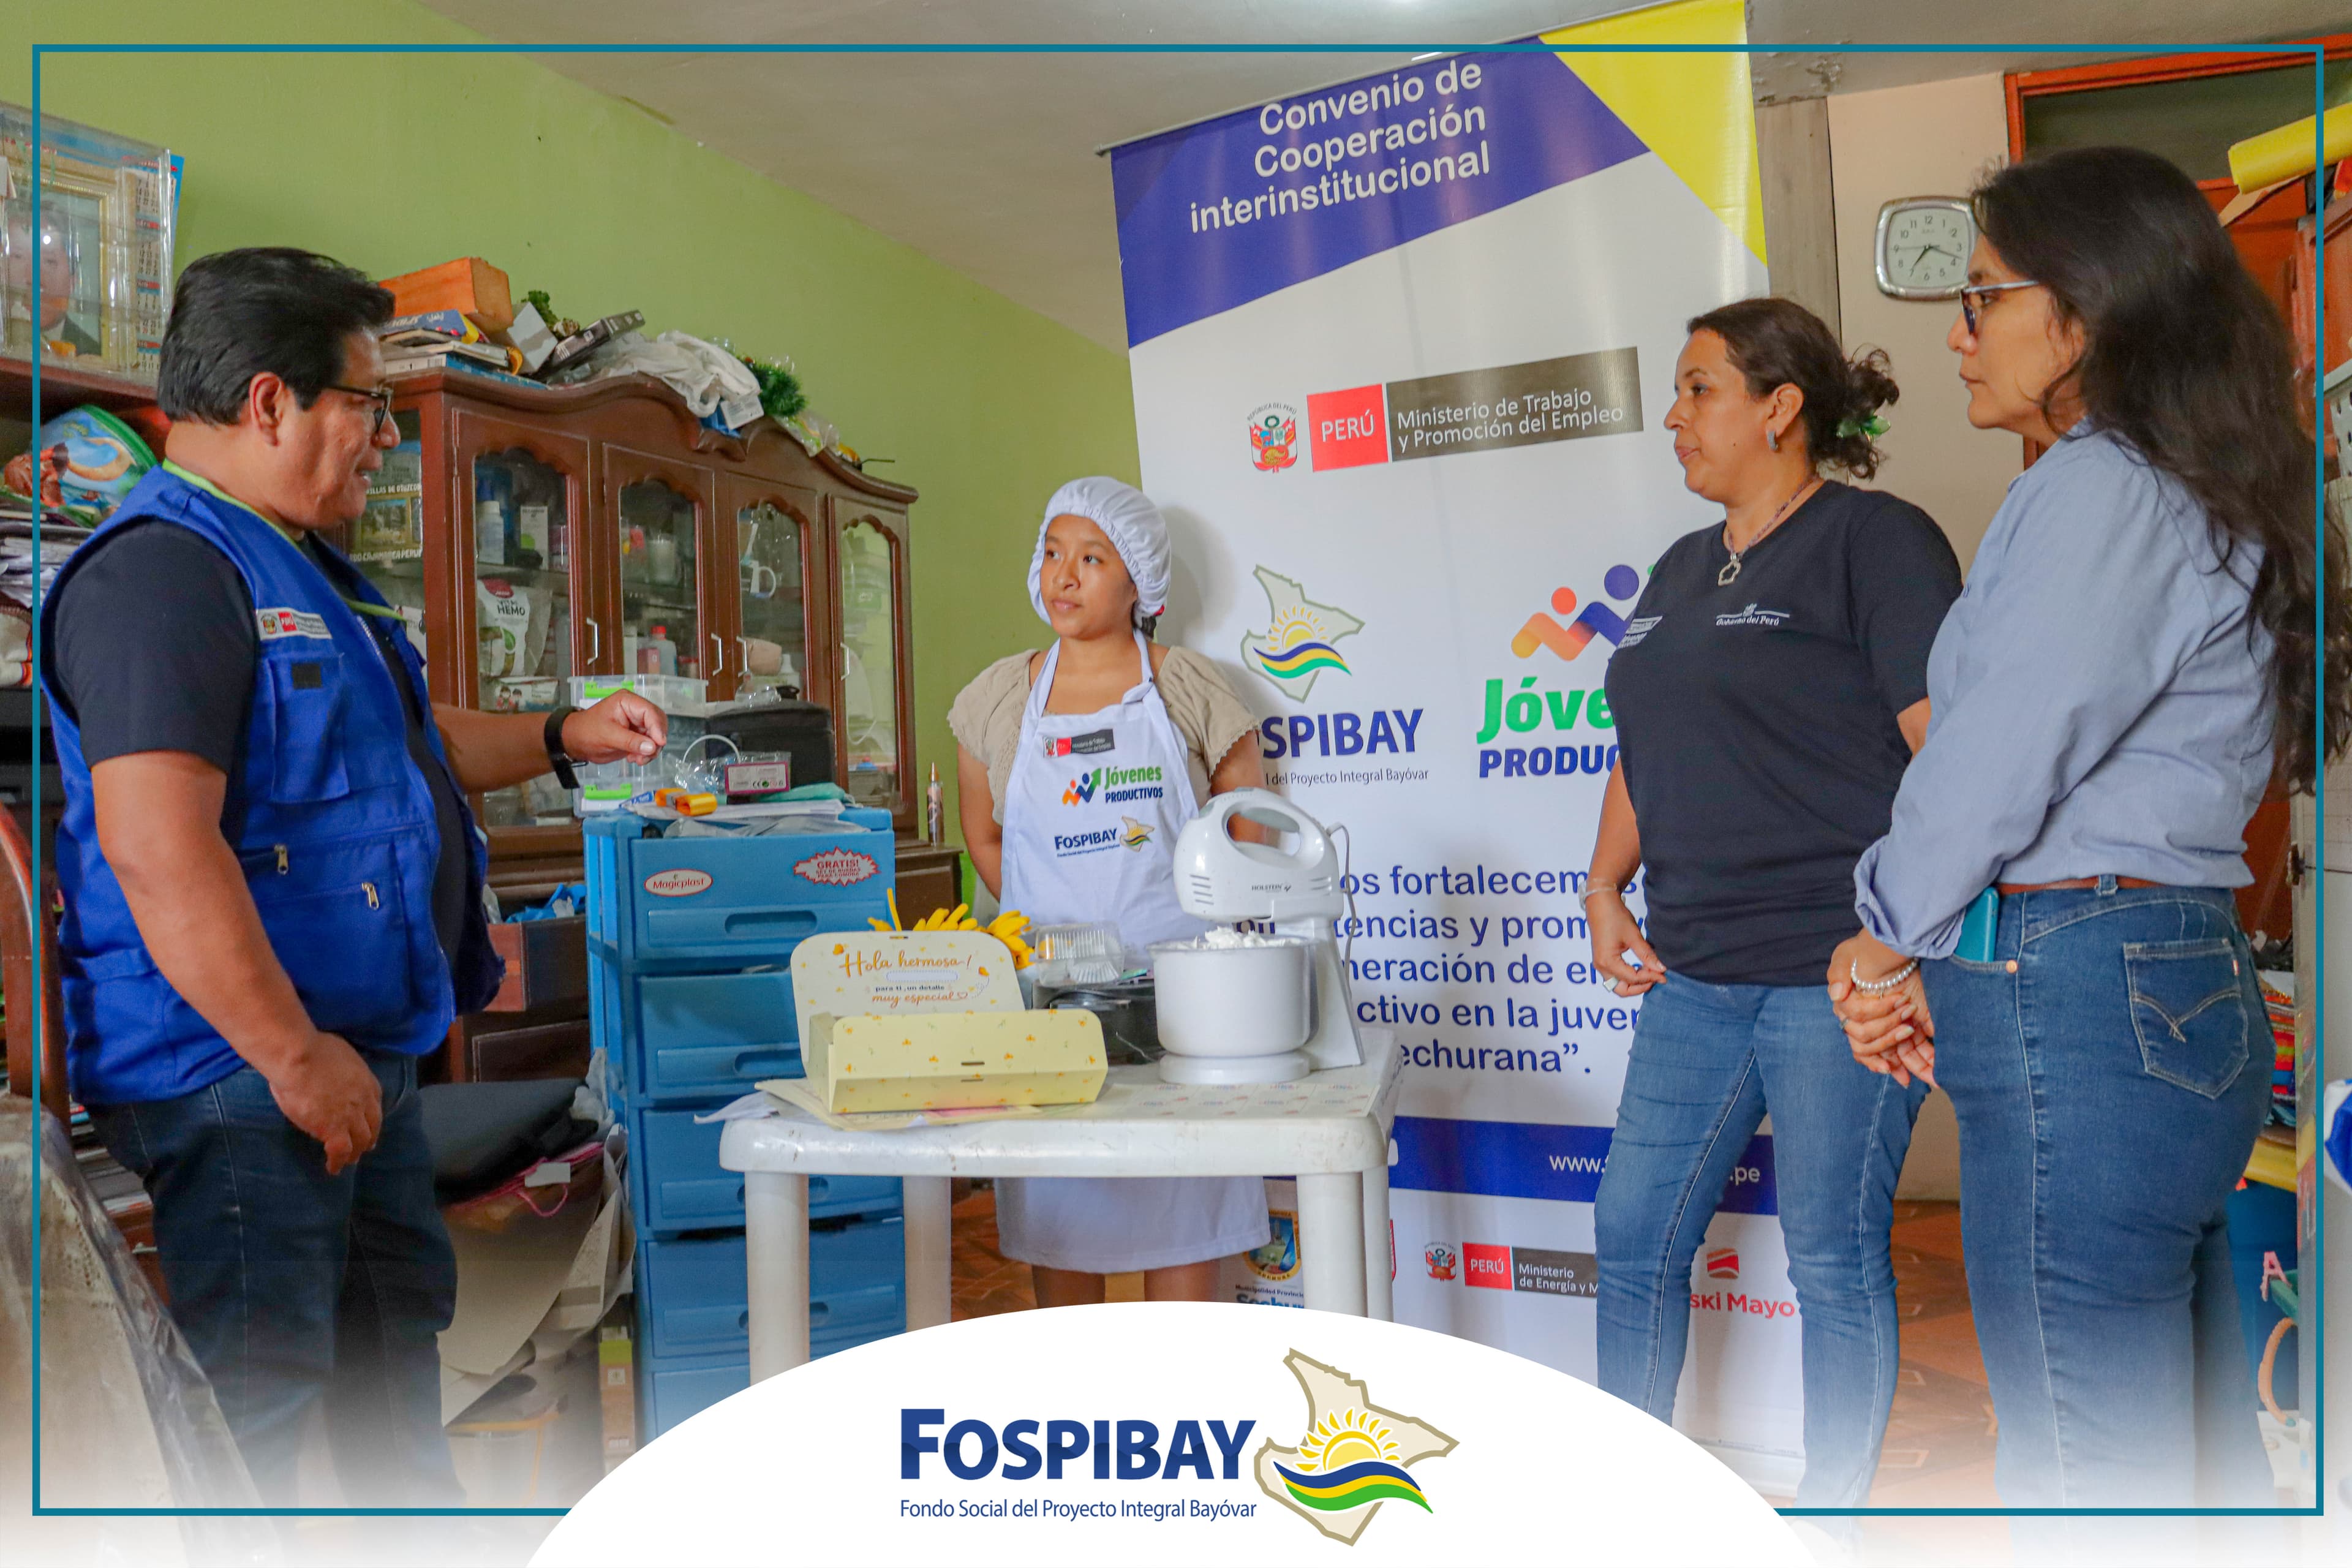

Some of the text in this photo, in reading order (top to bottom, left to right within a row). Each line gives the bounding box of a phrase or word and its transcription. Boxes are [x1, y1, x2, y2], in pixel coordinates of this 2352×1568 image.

[1260, 59, 1482, 135] Convenio de
[1254, 104, 1486, 178] Cooperación
[1190, 140, 1491, 233] interinstitucional
[1398, 388, 1592, 429] Ministerio de Trabajo
[1321, 409, 1374, 442] PERÚ
[1398, 405, 1624, 453] y Promoción del Empleo
[1476, 676, 1615, 744] Jóve
[1257, 708, 1424, 759] SPIBAY
[1104, 766, 1163, 790] Jóvenes
[1272, 772, 1288, 785] del
[1291, 772, 1337, 787] Proyecto
[1340, 768, 1383, 785] Integral
[1386, 766, 1429, 784] Bayóvar
[1105, 787, 1163, 804] PRODUCTIVOS
[1054, 827, 1117, 850] FOSPIBAY
[653, 877, 705, 891] Magicplast
[1339, 873, 1381, 895] os
[1470, 916, 1489, 947] y
[839, 950, 892, 978] Hola
[1507, 954, 1553, 984] de
[872, 992, 954, 1009] muy especial
[1357, 995, 1640, 1036] ctivo en la juve
[1549, 1155, 1607, 1174] www.
[1470, 1257, 1505, 1275] PERÚ
[1519, 1263, 1574, 1279] Ministerio
[1520, 1277, 1533, 1288] de
[1536, 1277, 1577, 1294] Energía
[1579, 1283, 1586, 1294] y
[1690, 1293, 1795, 1319] ski Mayo
